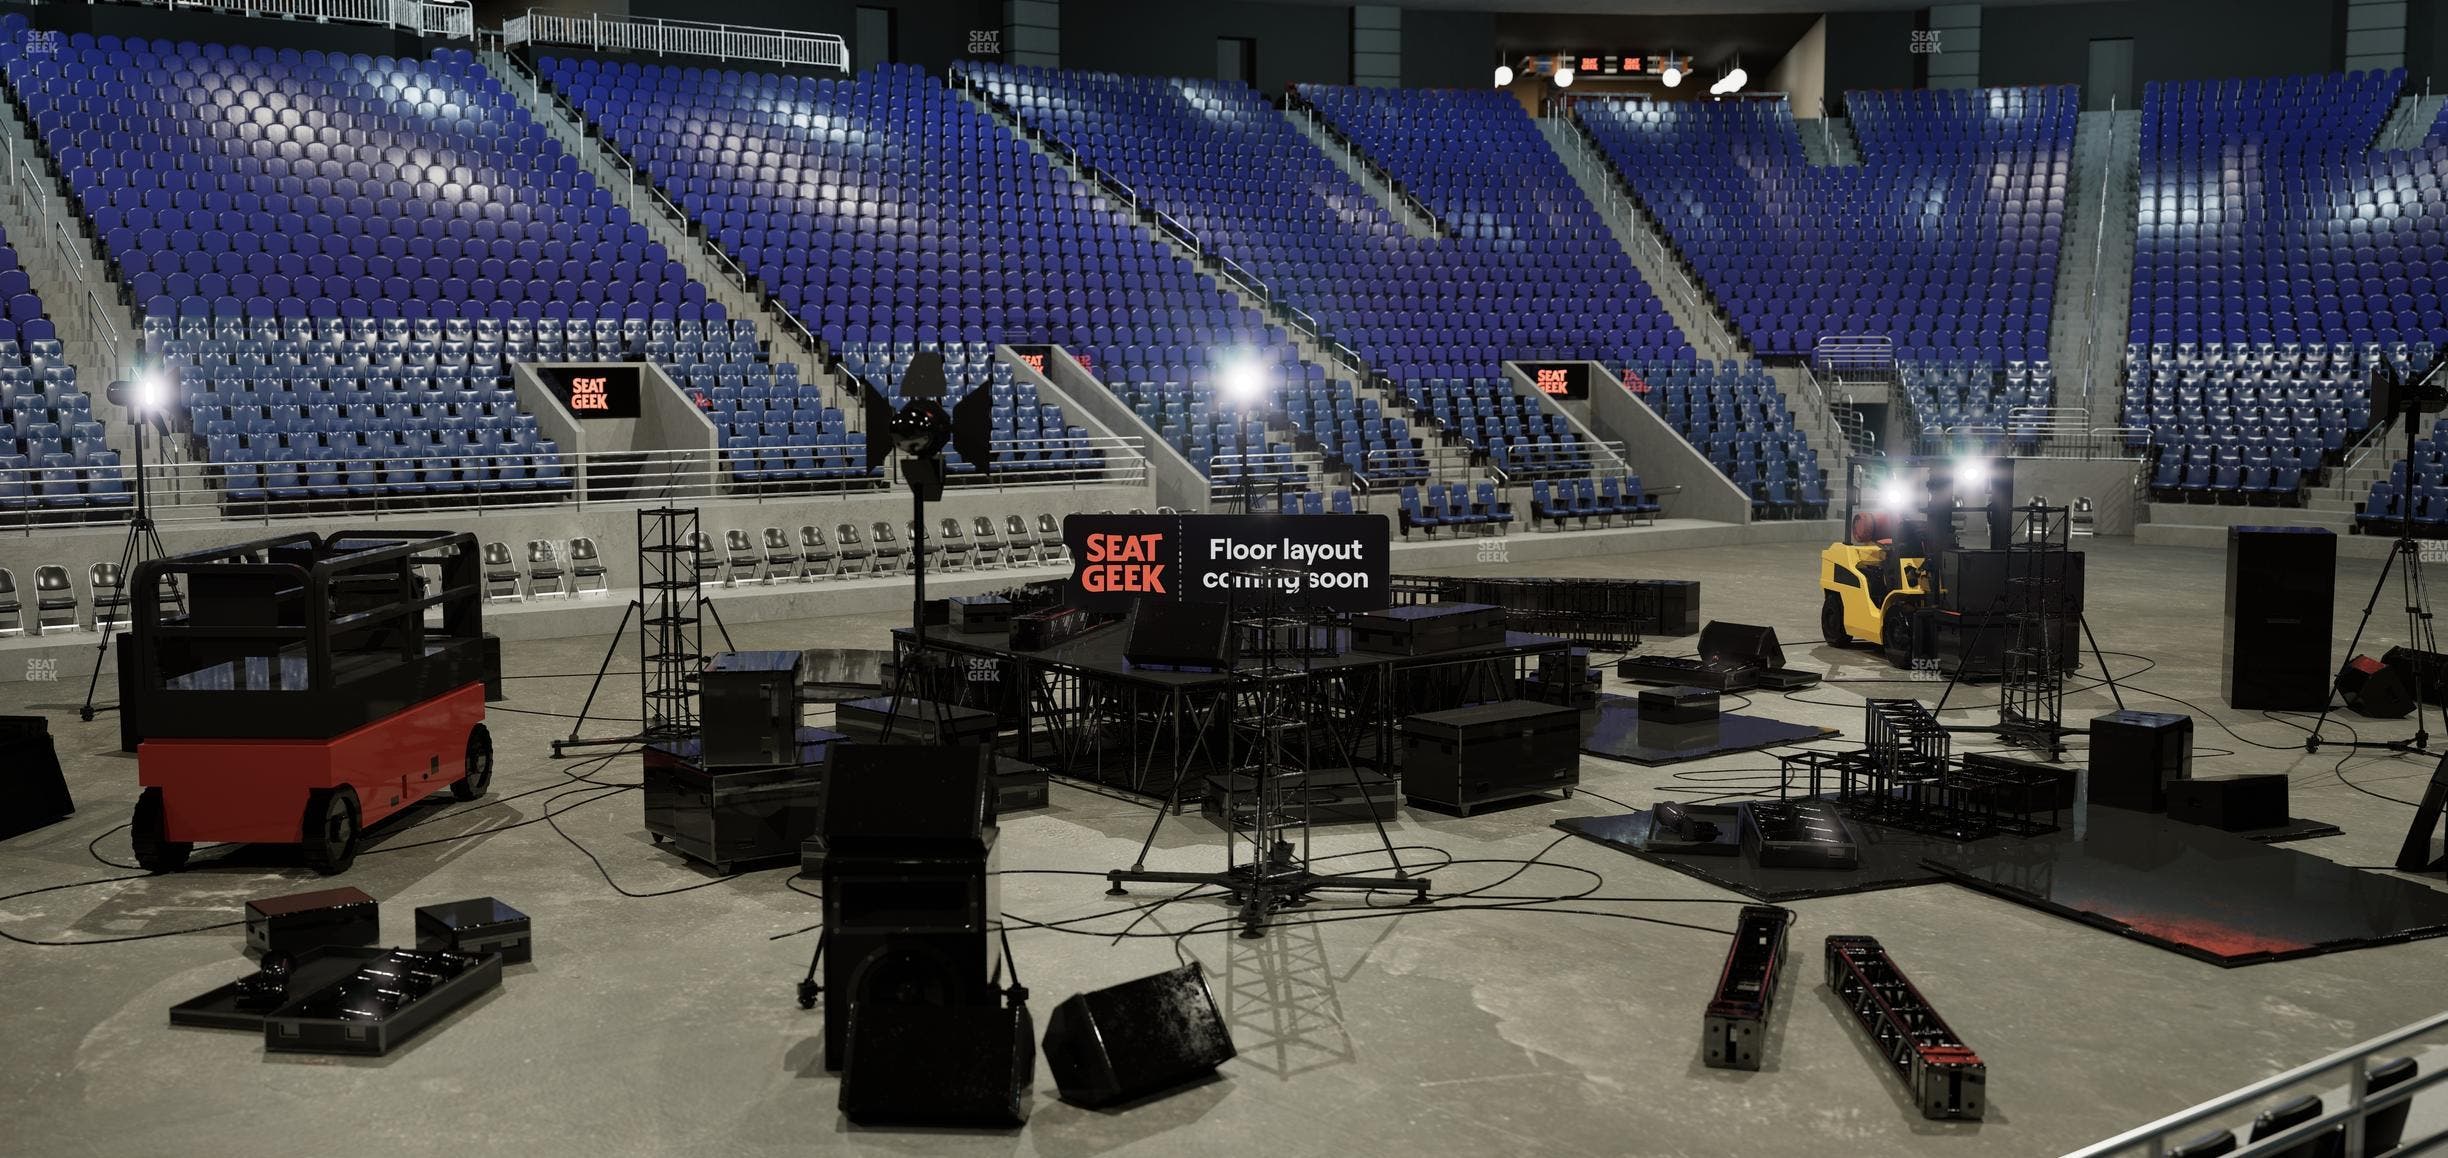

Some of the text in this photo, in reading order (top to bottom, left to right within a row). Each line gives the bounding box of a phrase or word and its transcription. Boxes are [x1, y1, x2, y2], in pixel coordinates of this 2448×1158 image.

[1538, 369, 1567, 381] SEAT
[573, 378, 606, 393] SEAT
[1537, 381, 1568, 394] GEEK
[571, 393, 608, 410] GEEK
[1087, 533, 1163, 562] SEAT
[1210, 538, 1363, 566] Floor layout
[1081, 564, 1167, 594] GEEK
[1203, 572, 1369, 594] comng soon
